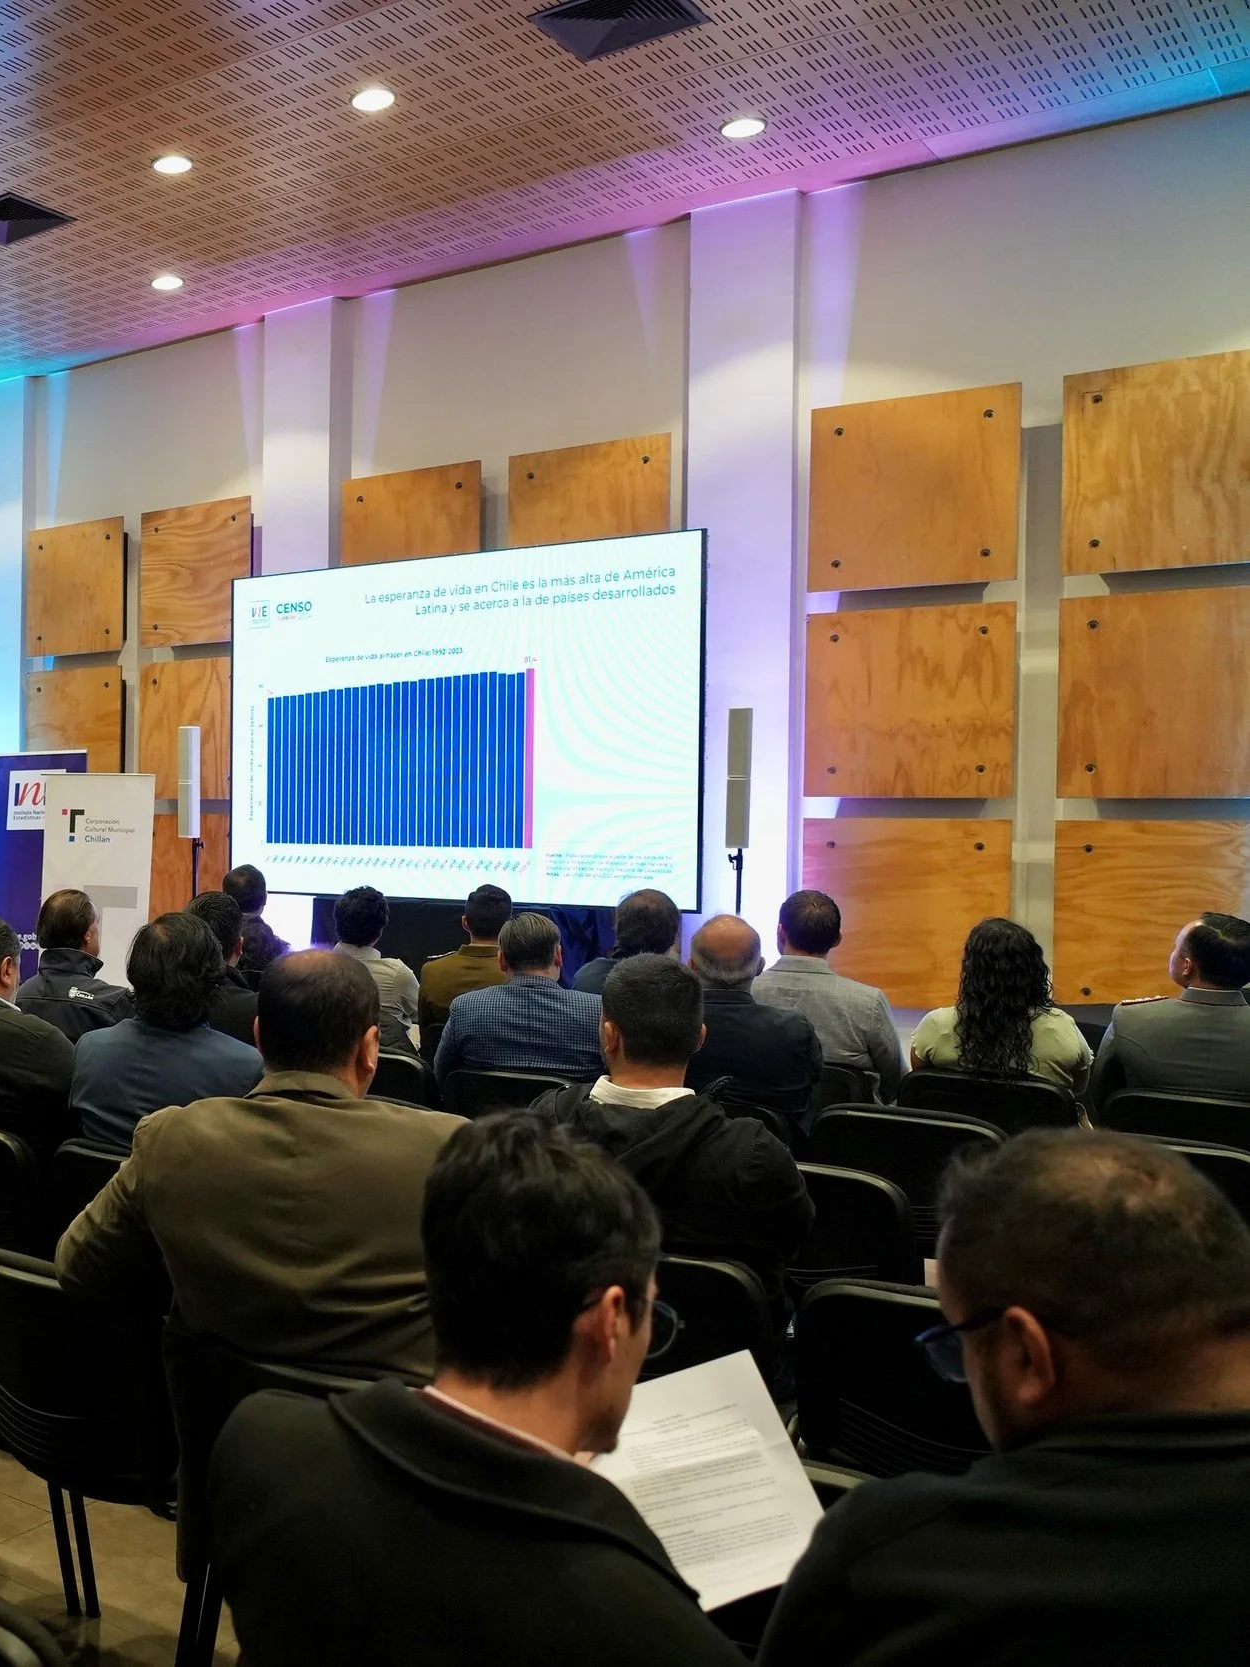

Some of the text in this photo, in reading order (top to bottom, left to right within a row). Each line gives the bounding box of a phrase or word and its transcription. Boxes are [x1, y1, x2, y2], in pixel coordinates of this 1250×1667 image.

[364, 566, 676, 604] La esperanza de vida en Chile es la más alta de América
[415, 584, 676, 615] Latina y se acerca a la de países desarrollados
[276, 601, 312, 614] CENSO
[325, 655, 355, 663] Esperanza
[365, 652, 378, 660] vida
[386, 650, 403, 659] nacer
[84, 835, 110, 843] Chillán
